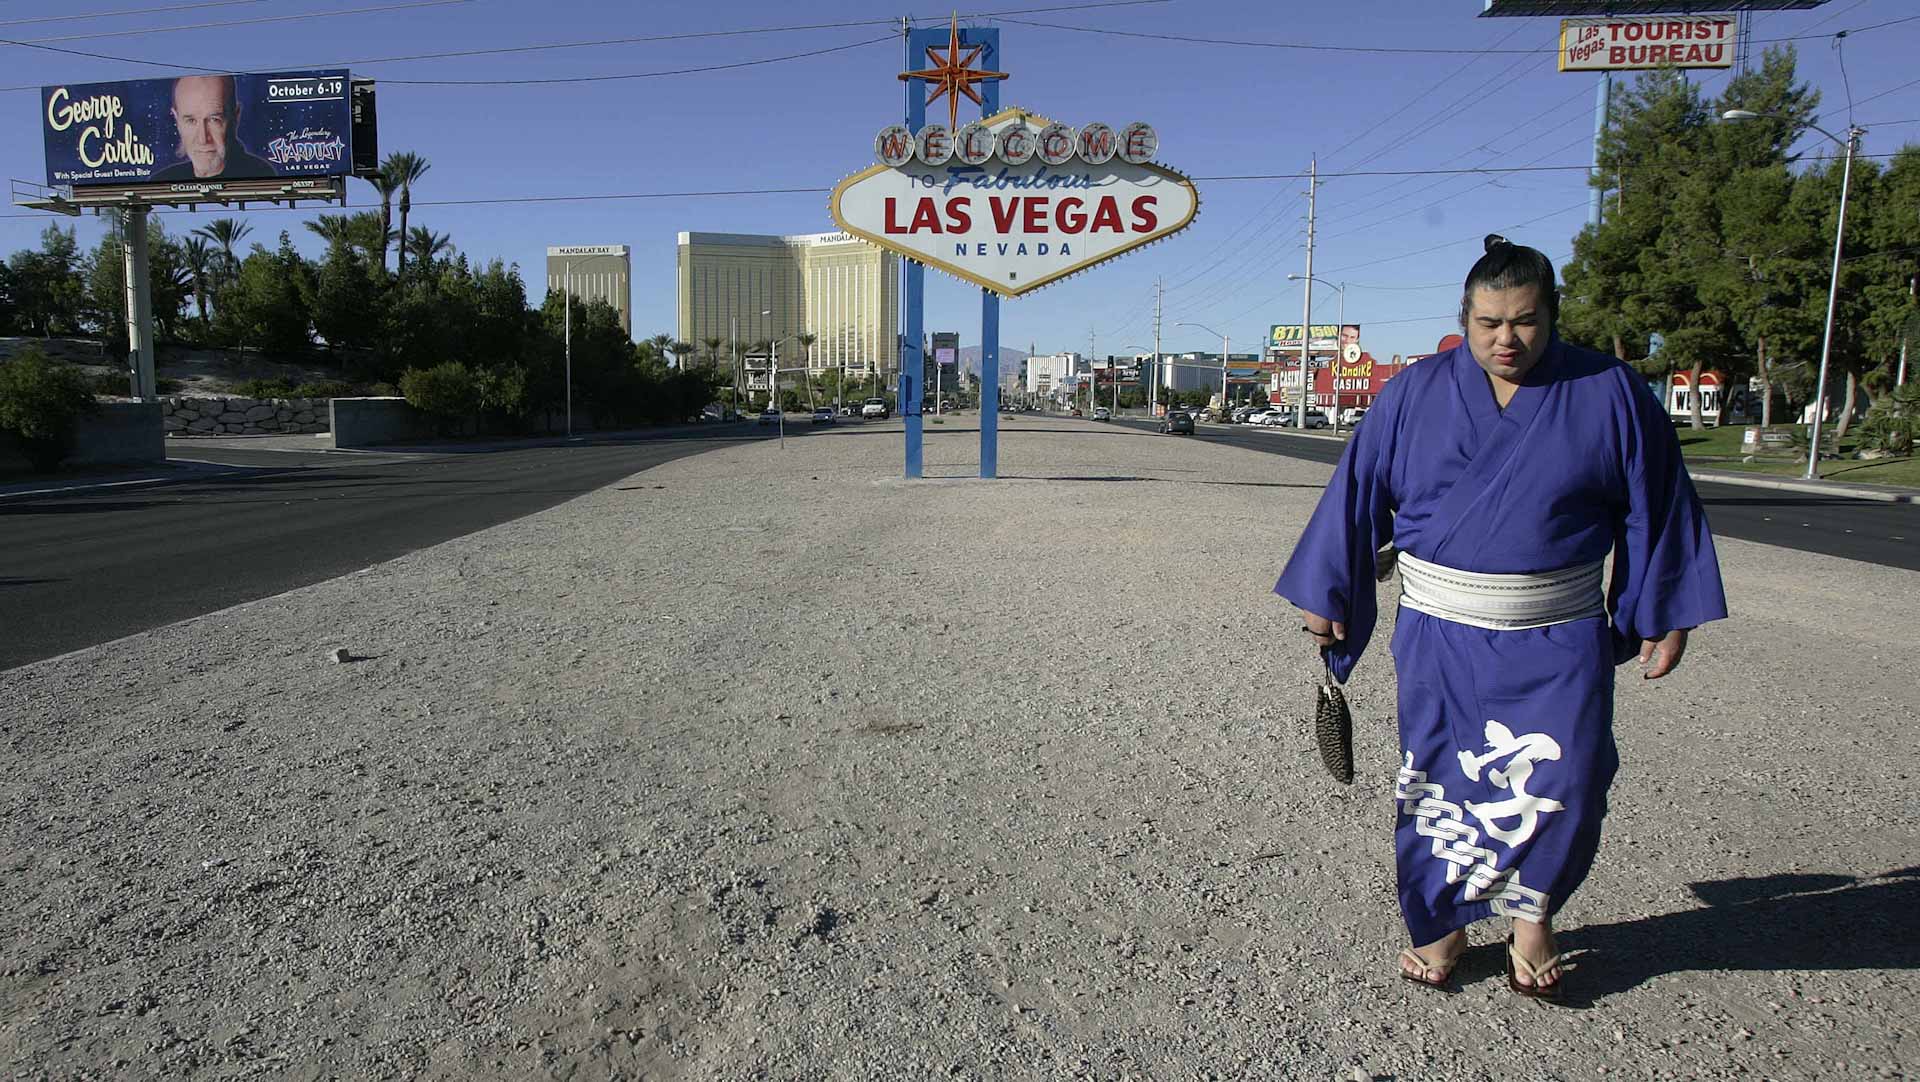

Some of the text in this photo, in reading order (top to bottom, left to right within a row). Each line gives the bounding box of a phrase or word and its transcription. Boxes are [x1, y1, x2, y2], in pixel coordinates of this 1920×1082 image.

[1577, 24, 1600, 44] Las
[1606, 20, 1730, 42] TOURIST
[1569, 37, 1605, 63] Vegas
[1608, 43, 1724, 64] BUREAU
[269, 81, 342, 98] October 6-19
[48, 87, 123, 139] George
[79, 123, 154, 168] Carlin
[268, 136, 345, 163] STARDUST
[880, 129, 1149, 159] WELCOME
[54, 167, 151, 181] With Special Guest Dennis Blair
[907, 165, 1093, 196] TO Fabulous
[884, 195, 1158, 235] LAS VEGAS
[955, 243, 1071, 257] NEVADA
